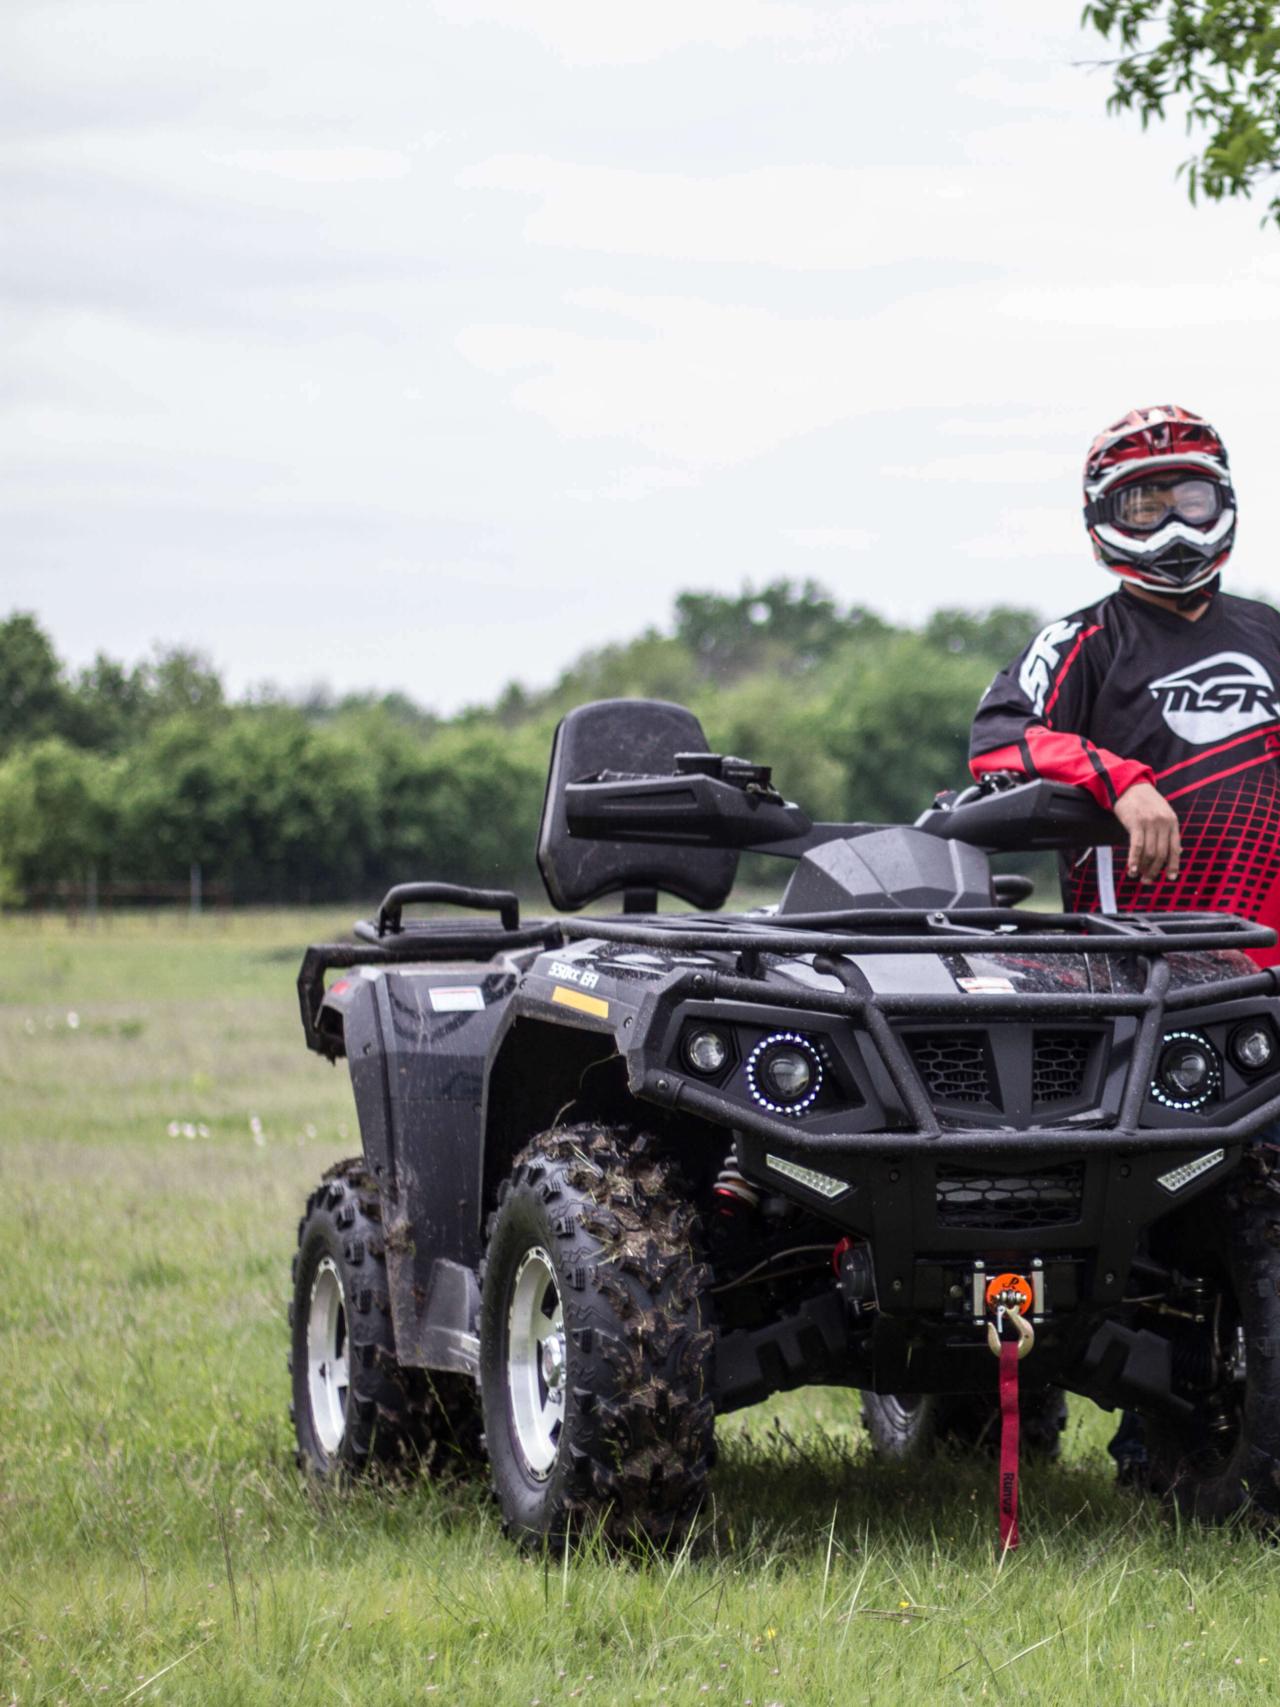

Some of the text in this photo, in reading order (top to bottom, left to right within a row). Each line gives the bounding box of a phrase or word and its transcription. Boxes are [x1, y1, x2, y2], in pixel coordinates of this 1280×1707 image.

[1018, 620, 1084, 717] SR
[1157, 683, 1280, 719] MSR
[548, 961, 600, 989] 550cc EFI
